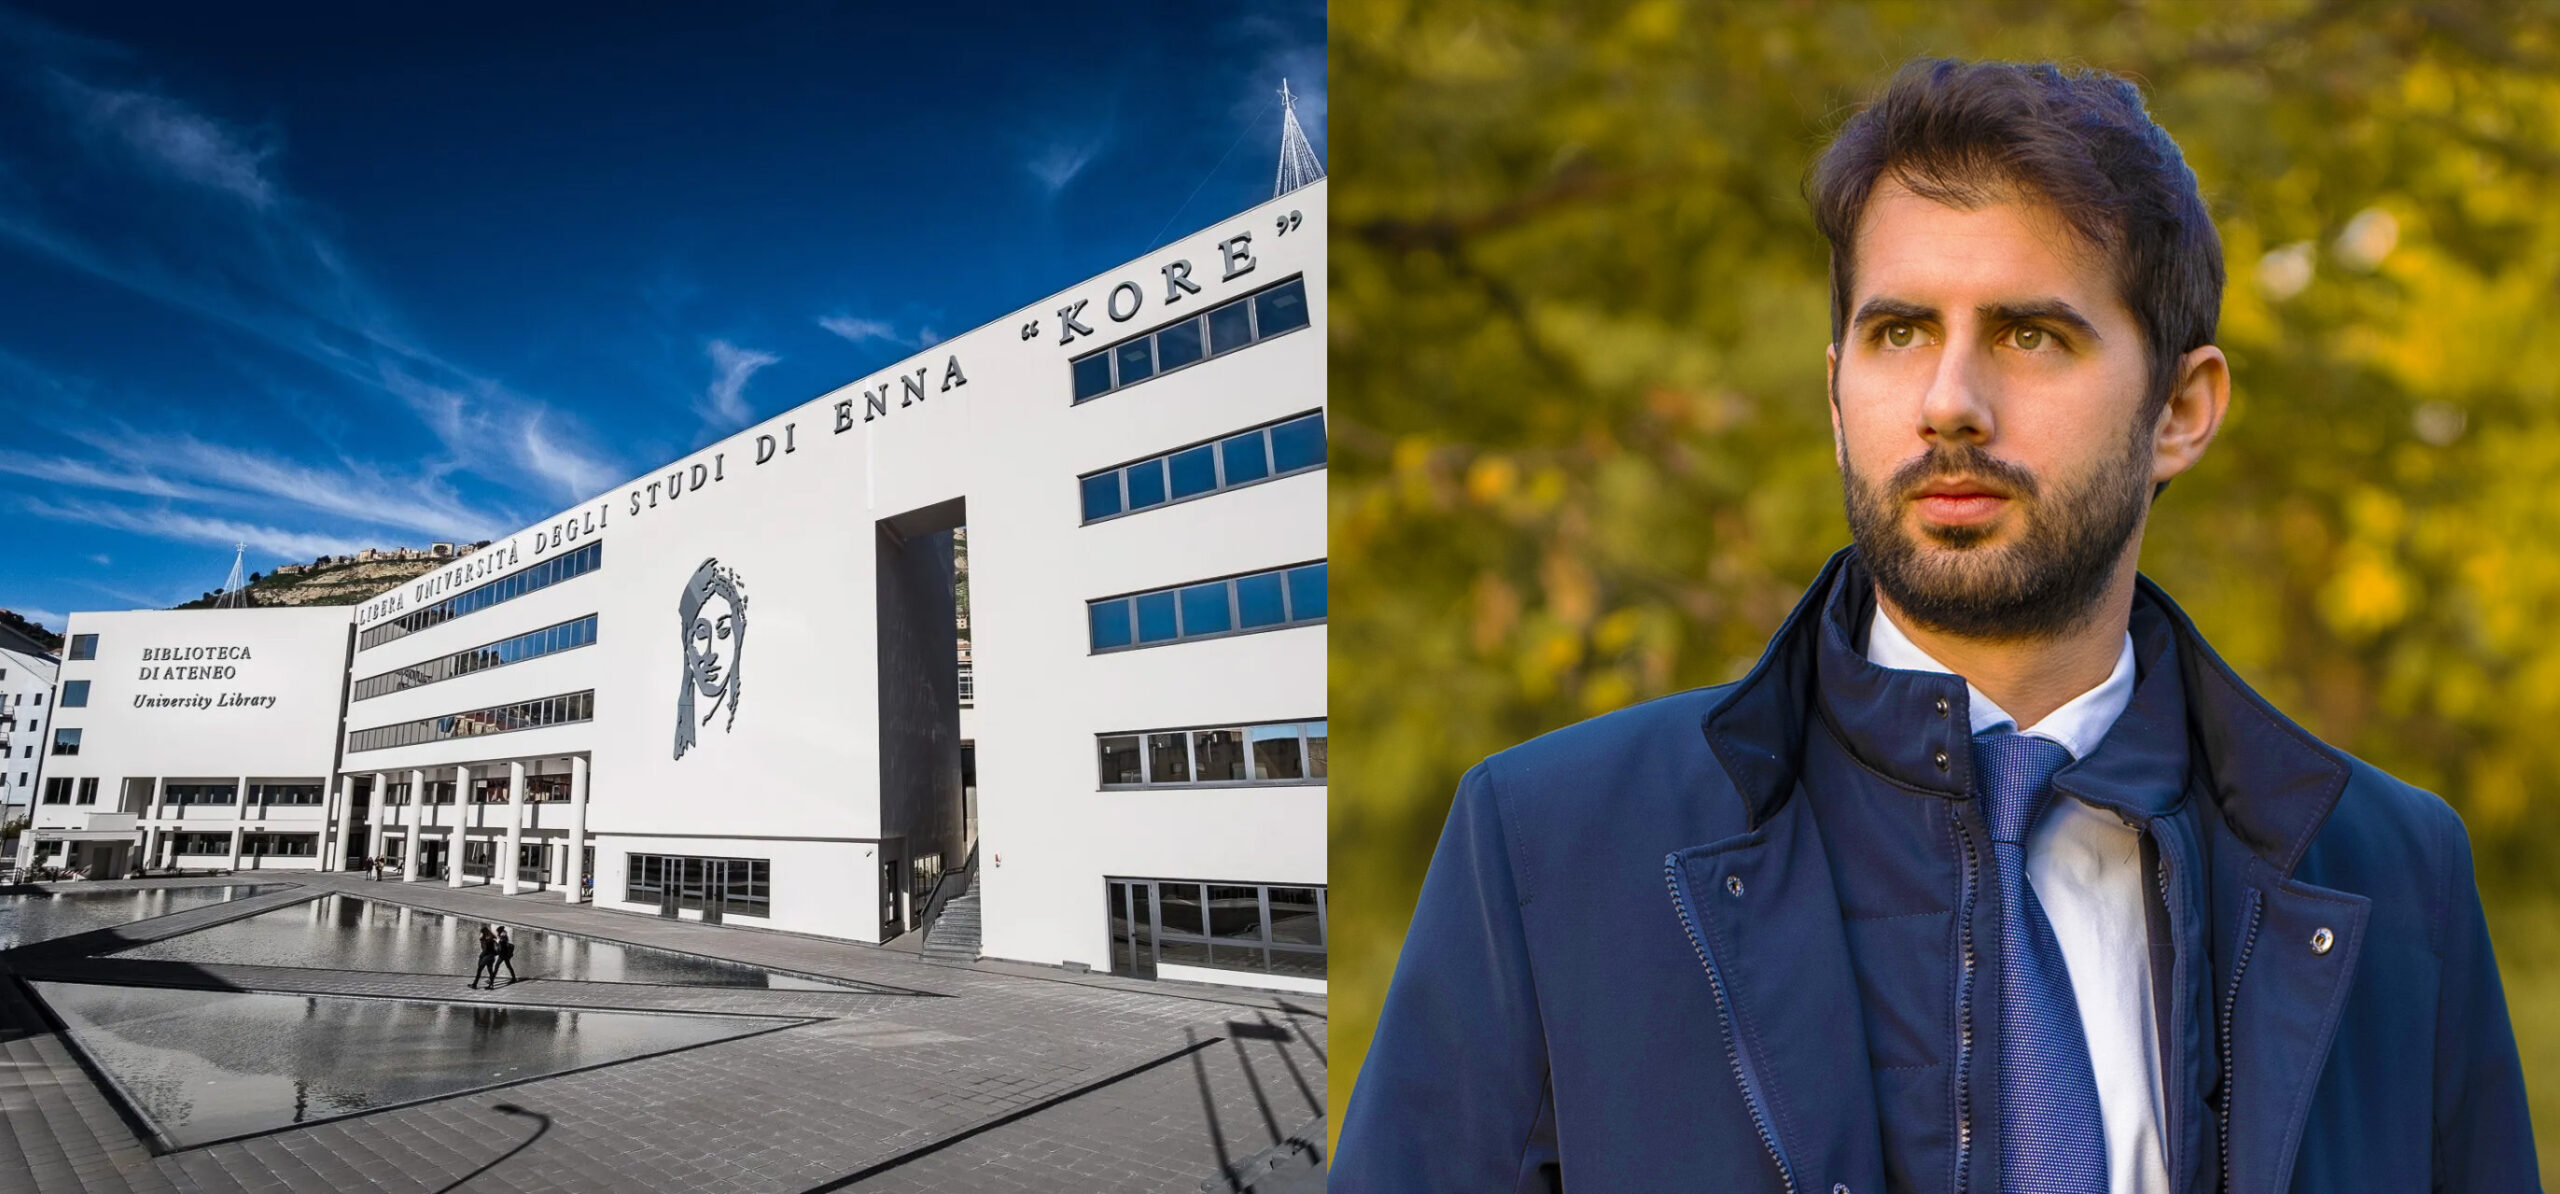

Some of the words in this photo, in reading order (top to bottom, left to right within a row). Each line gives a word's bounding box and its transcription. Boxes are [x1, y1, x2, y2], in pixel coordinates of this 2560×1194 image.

[359, 592, 404, 625] LIBERA
[415, 538, 519, 603] UNIVERSITÀ
[534, 503, 608, 555] DEGLI
[629, 453, 725, 516] STUDI
[755, 422, 796, 465] DI
[833, 354, 968, 435] ENNA
[142, 646, 252, 661] BIBLIOTECA
[138, 667, 160, 680] DI
[163, 665, 237, 680] ATENEO
[133, 693, 213, 710] University
[216, 692, 277, 709] Library
